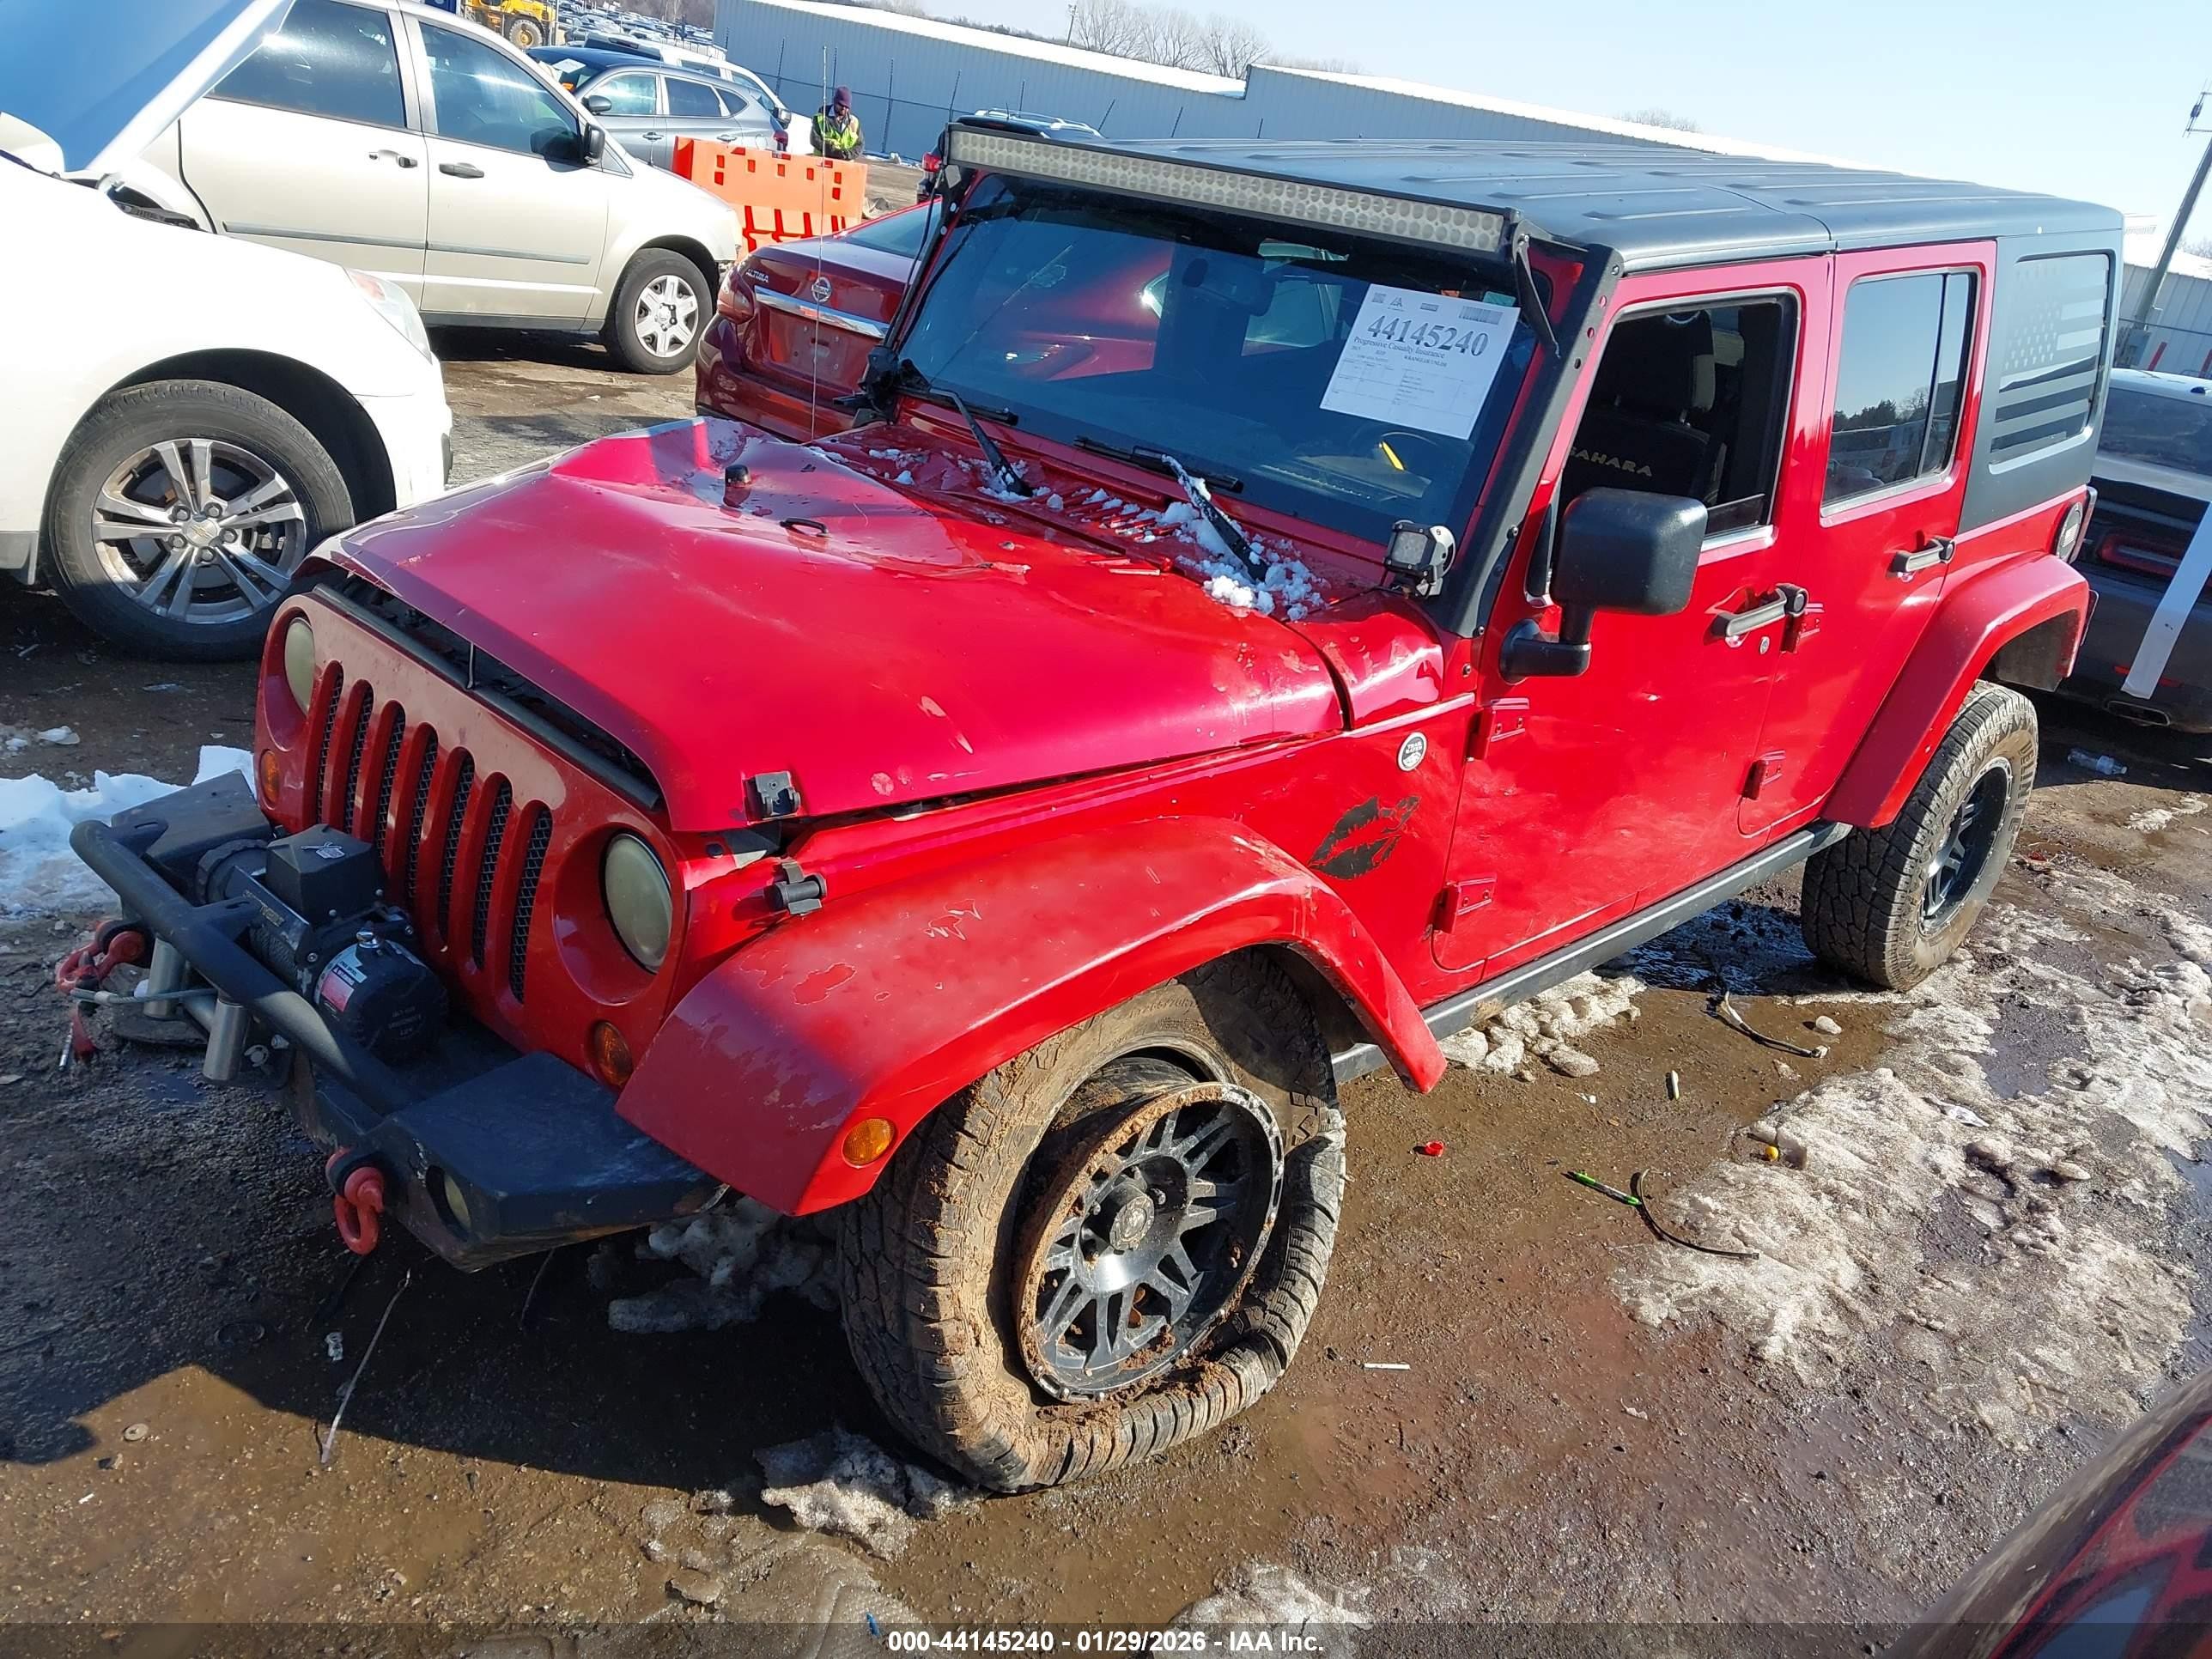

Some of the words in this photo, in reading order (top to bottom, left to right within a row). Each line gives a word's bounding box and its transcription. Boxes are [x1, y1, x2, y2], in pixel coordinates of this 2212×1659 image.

[745, 269, 769, 283] ALTIMA
[1367, 315, 1488, 356] 44145240
[1353, 336, 1389, 350] Progressive
[1388, 342, 1414, 355] Casualty
[1414, 347, 1446, 359] Insurance
